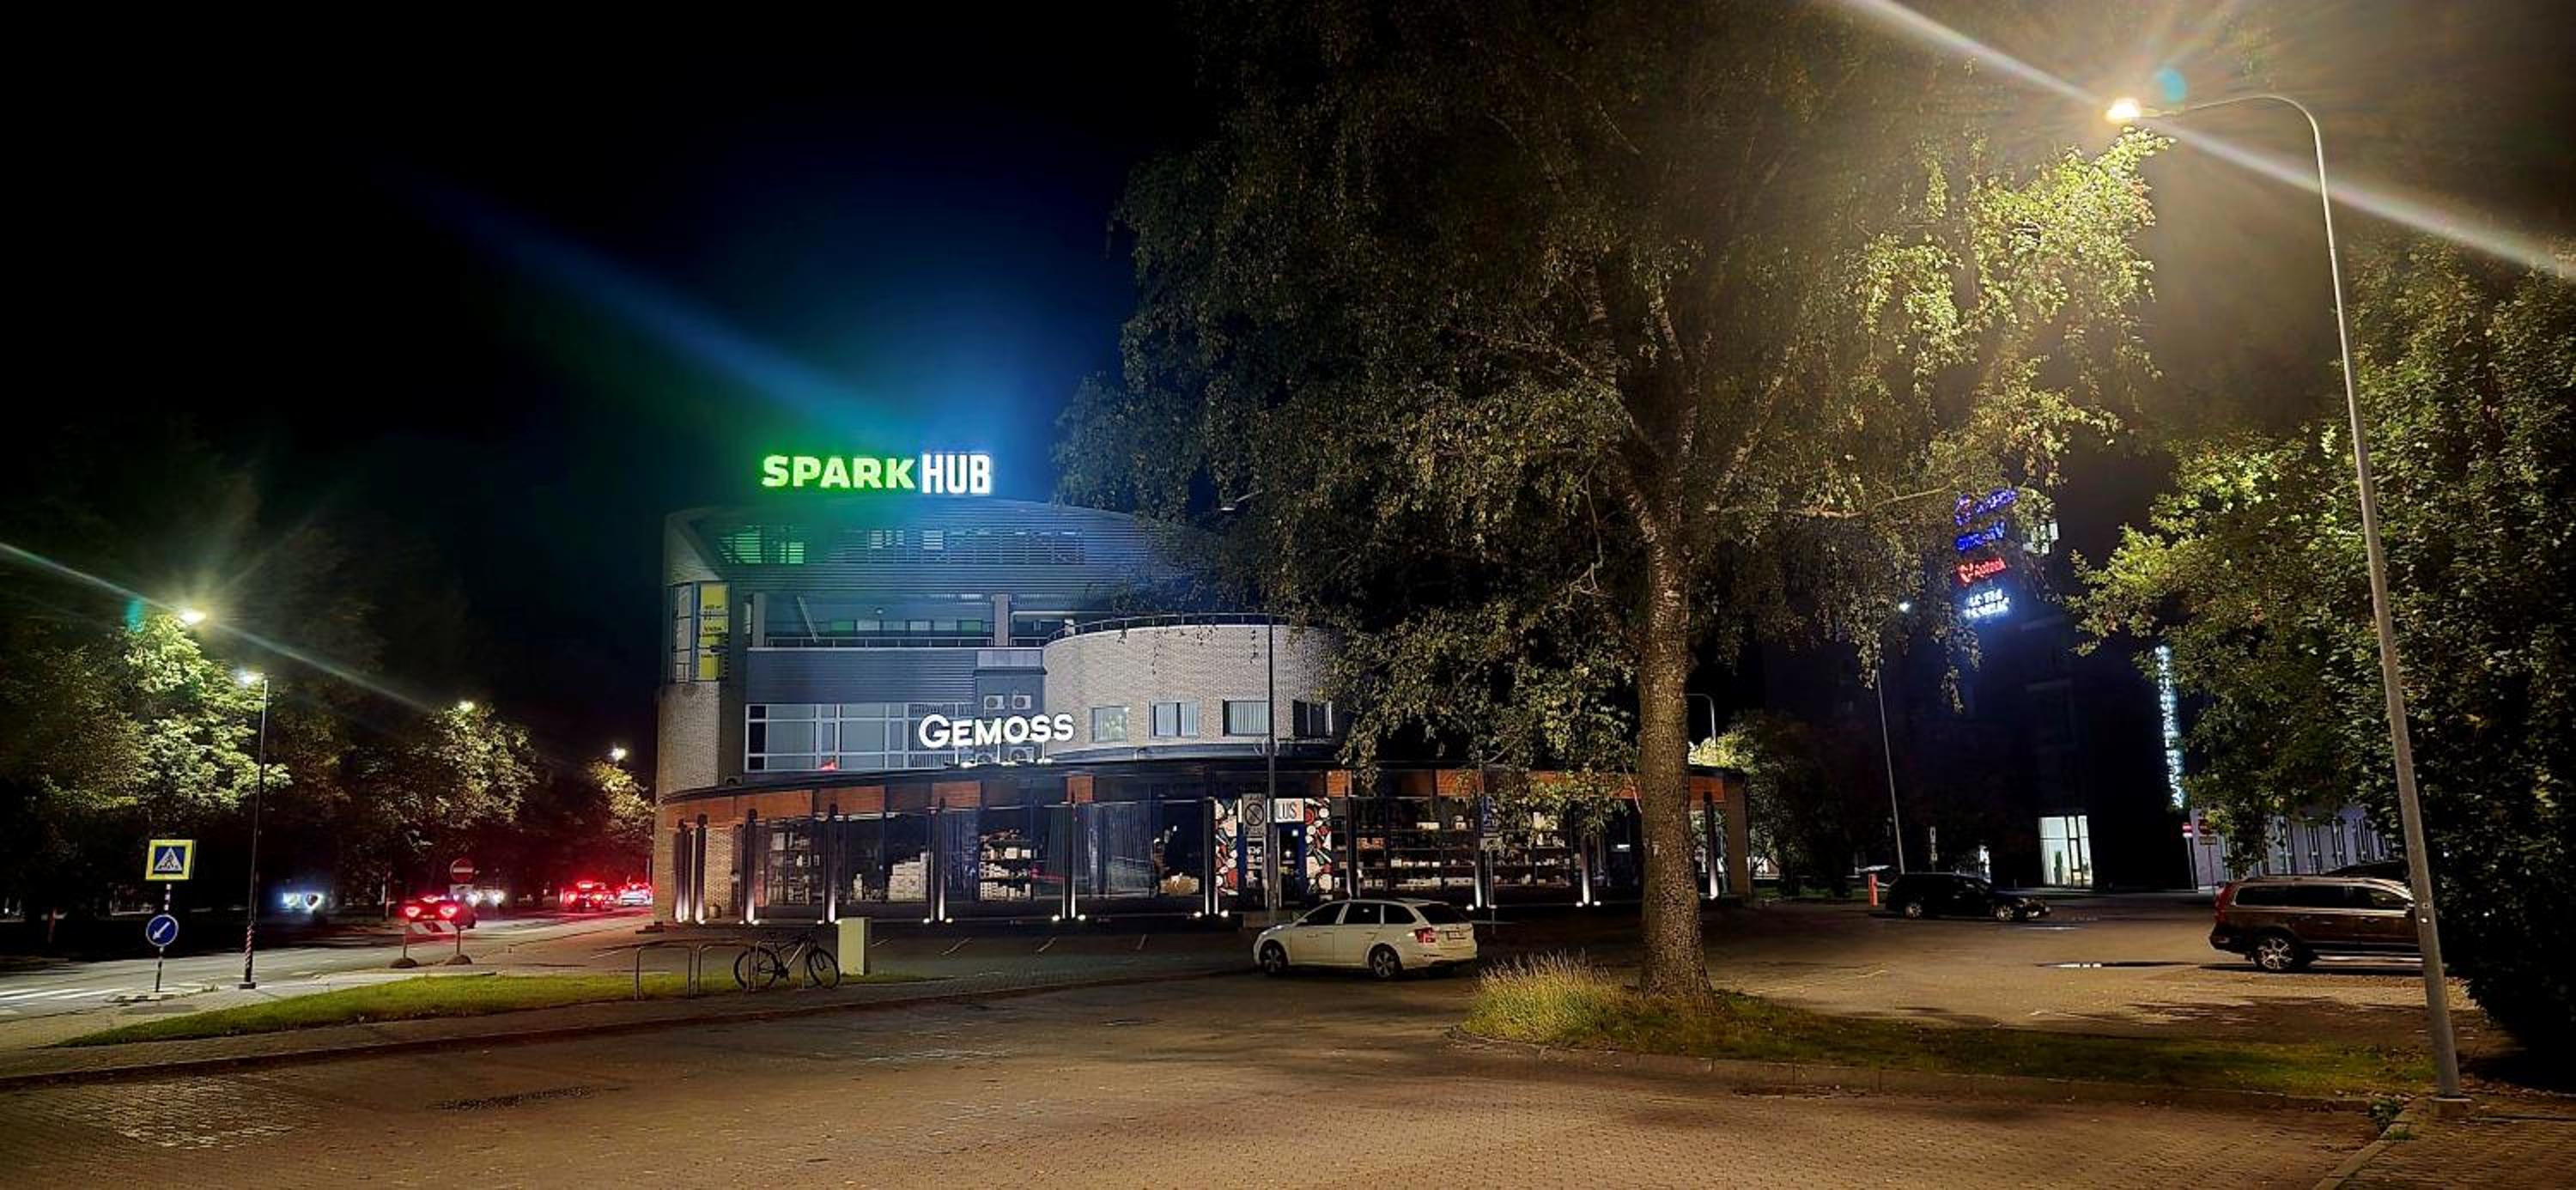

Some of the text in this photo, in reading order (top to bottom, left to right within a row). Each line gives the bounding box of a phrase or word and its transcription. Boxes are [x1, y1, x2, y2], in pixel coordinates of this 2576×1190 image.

[762, 452, 992, 495] SPARK HUB
[918, 713, 1075, 749] GEMOSS
